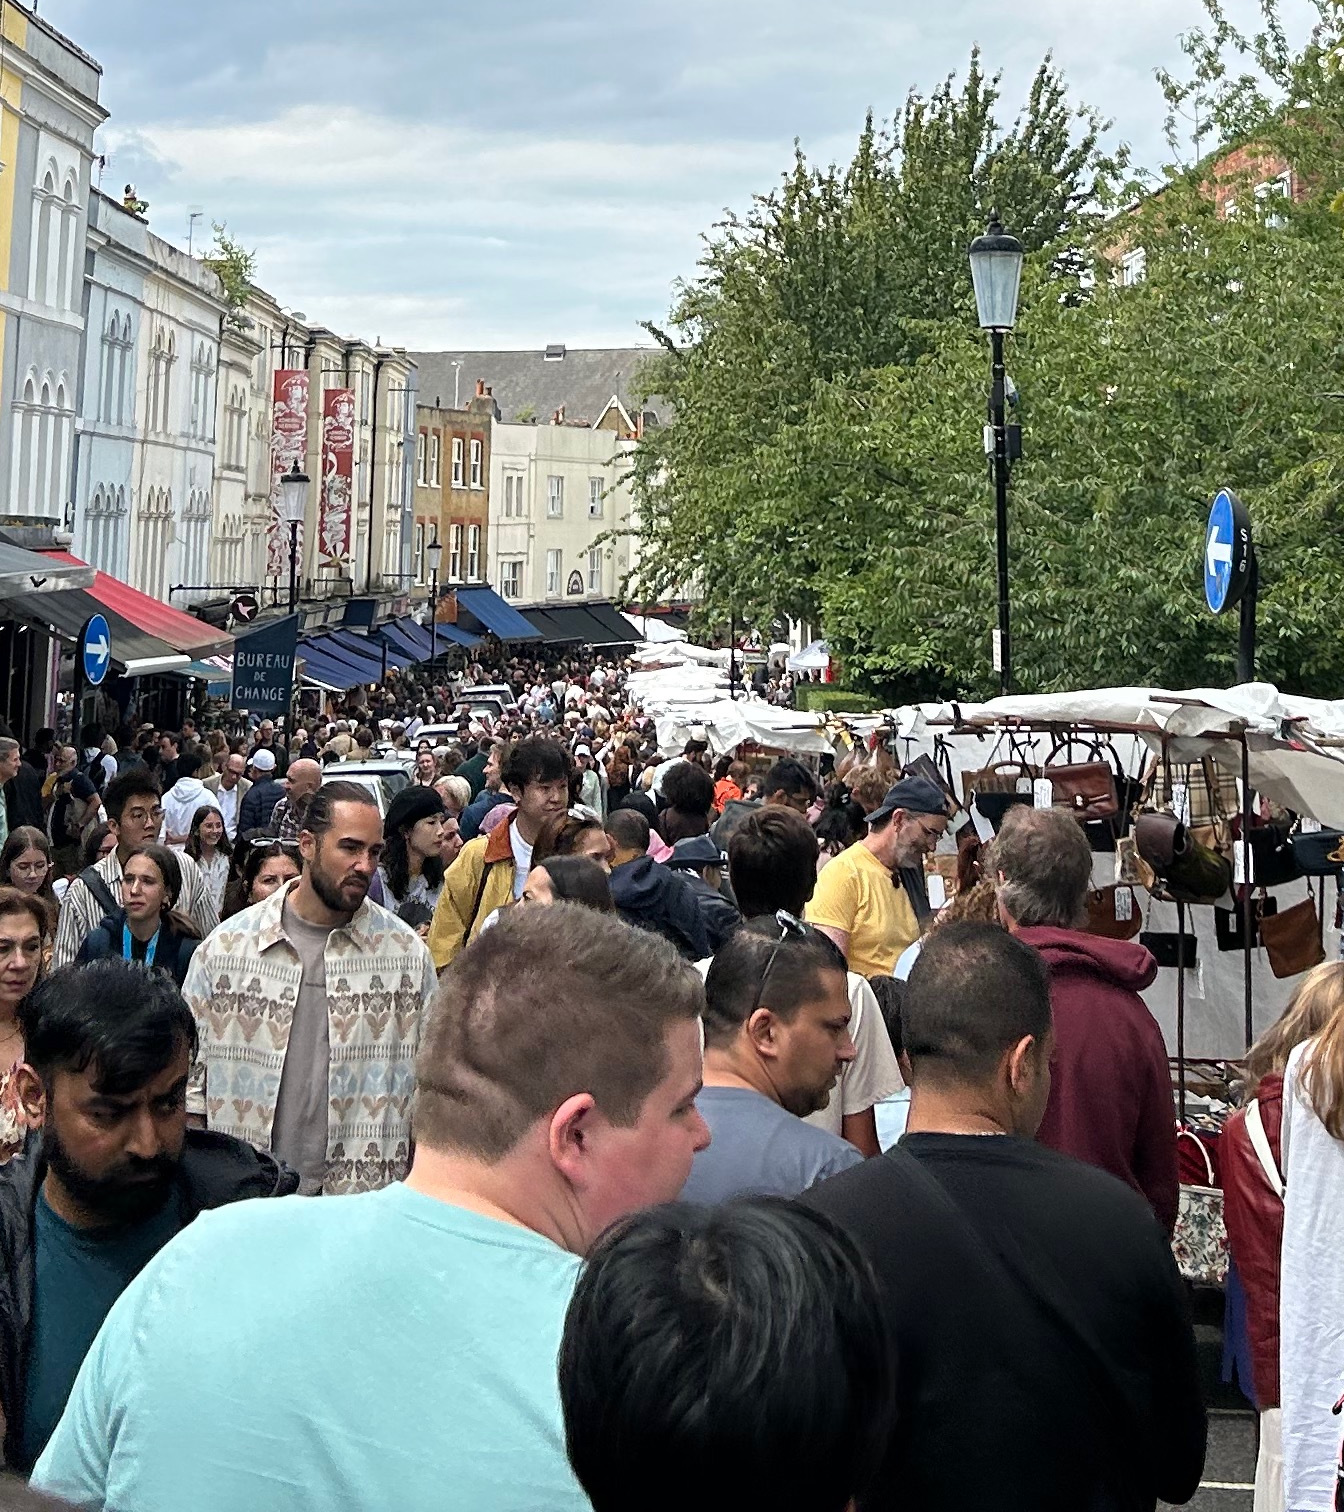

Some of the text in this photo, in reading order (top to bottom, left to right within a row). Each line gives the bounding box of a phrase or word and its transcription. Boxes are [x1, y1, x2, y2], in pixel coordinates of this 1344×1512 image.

[1239, 528, 1248, 573] S16
[237, 652, 290, 668] BUREAU
[254, 672, 267, 682] DE
[236, 686, 285, 701] CHANGE
